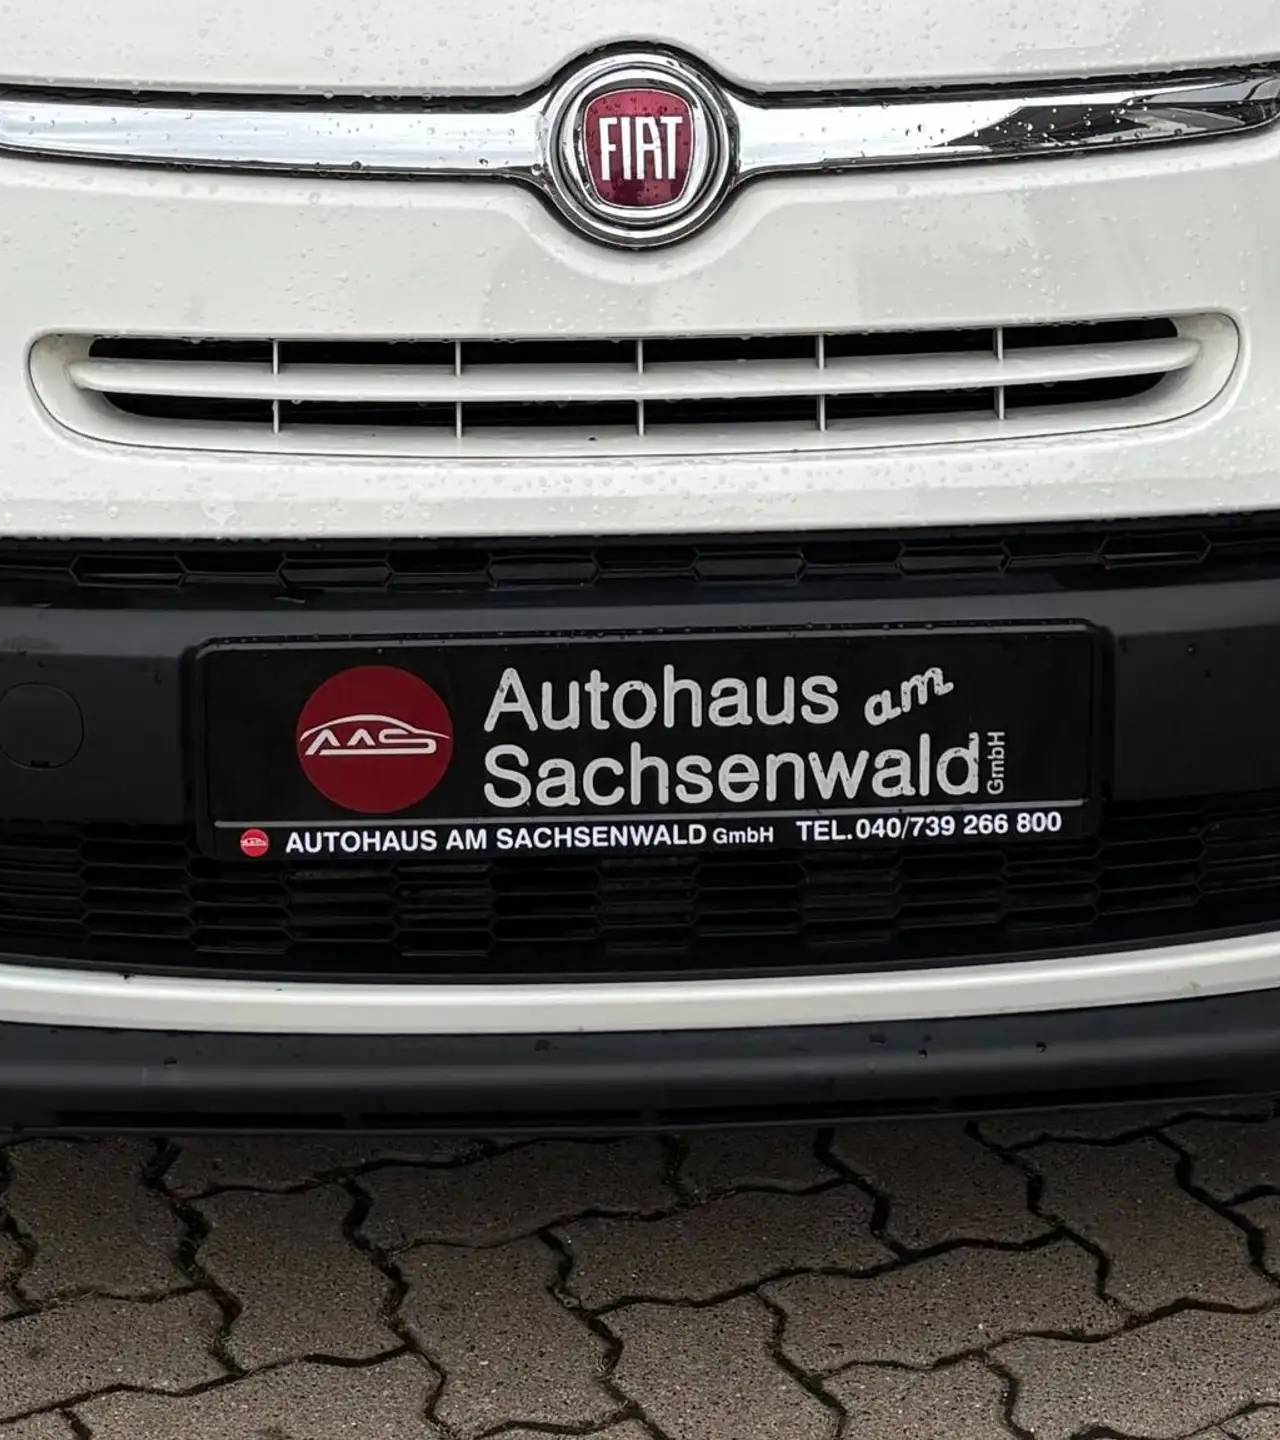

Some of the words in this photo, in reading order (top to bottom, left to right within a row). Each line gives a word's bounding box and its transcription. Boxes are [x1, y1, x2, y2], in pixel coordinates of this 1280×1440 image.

[598, 115, 683, 181] FIAT
[483, 663, 839, 732] Autohaus
[864, 666, 954, 726] am
[483, 731, 980, 809] Sachsenwald
[986, 731, 1006, 795] GmbH
[285, 829, 437, 853] AUTOHAUS
[445, 828, 487, 850] AM
[495, 824, 706, 849] SACHSENWALD
[712, 825, 774, 845] GmbH
[962, 812, 1009, 836] 266
[1016, 811, 1062, 834] 800
